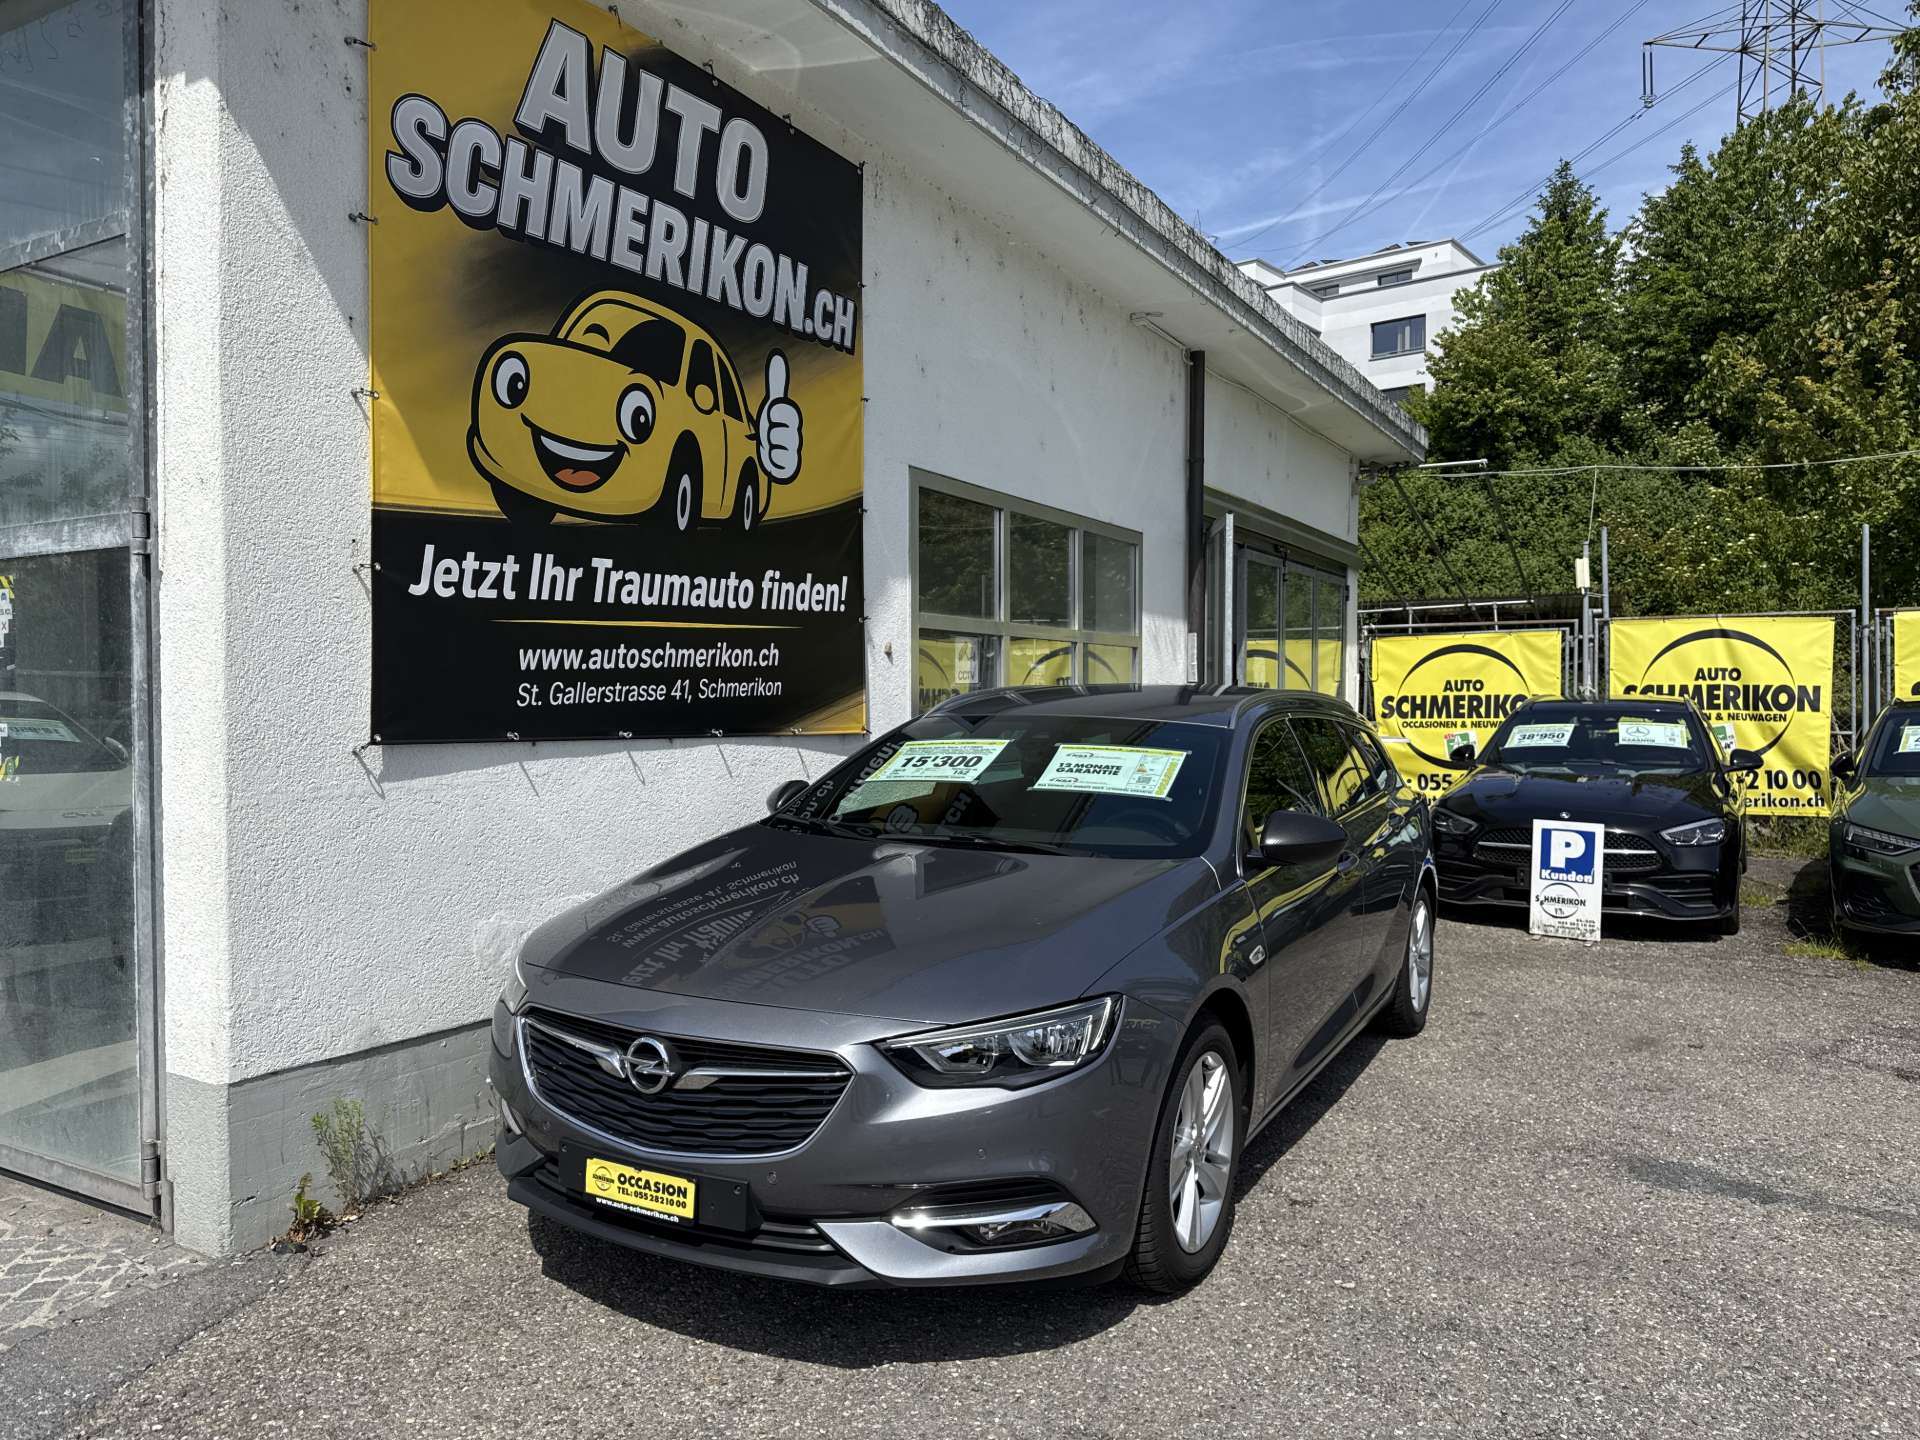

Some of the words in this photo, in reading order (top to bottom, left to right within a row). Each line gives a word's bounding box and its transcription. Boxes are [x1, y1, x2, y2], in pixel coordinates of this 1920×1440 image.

[515, 19, 768, 223] AUTO
[386, 95, 856, 351] SCHMERIKON.CH
[408, 544, 520, 600] Jetzt
[528, 552, 583, 602] Ihr
[591, 557, 754, 611] Traumauto
[760, 569, 848, 612] finden!
[518, 642, 780, 671] www.autoschmerikon.ch
[1694, 668, 1742, 682] AUTO
[516, 682, 542, 707] St.
[548, 680, 667, 706] Gallerstrasse
[670, 679, 693, 704] 41,
[698, 677, 783, 701] Schmerikon
[1443, 680, 1485, 692] AUTO
[1402, 720, 1458, 729] OCCASIONEN
[1460, 720, 1467, 729] &
[1715, 713, 1723, 721] &
[1728, 712, 1787, 723] NEUWAGEN
[1518, 732, 1566, 741] 38'950
[900, 755, 983, 768] 15'300
[1074, 762, 1123, 770] MONATE
[1056, 767, 1121, 776] GARANTIE
[1765, 769, 1788, 790] 10
[1792, 769, 1822, 790] 00
[1550, 830, 1586, 868] P
[1541, 869, 1593, 884] Kunden
[617, 1173, 688, 1199] OCCASION
[633, 1190, 649, 1201] 055
